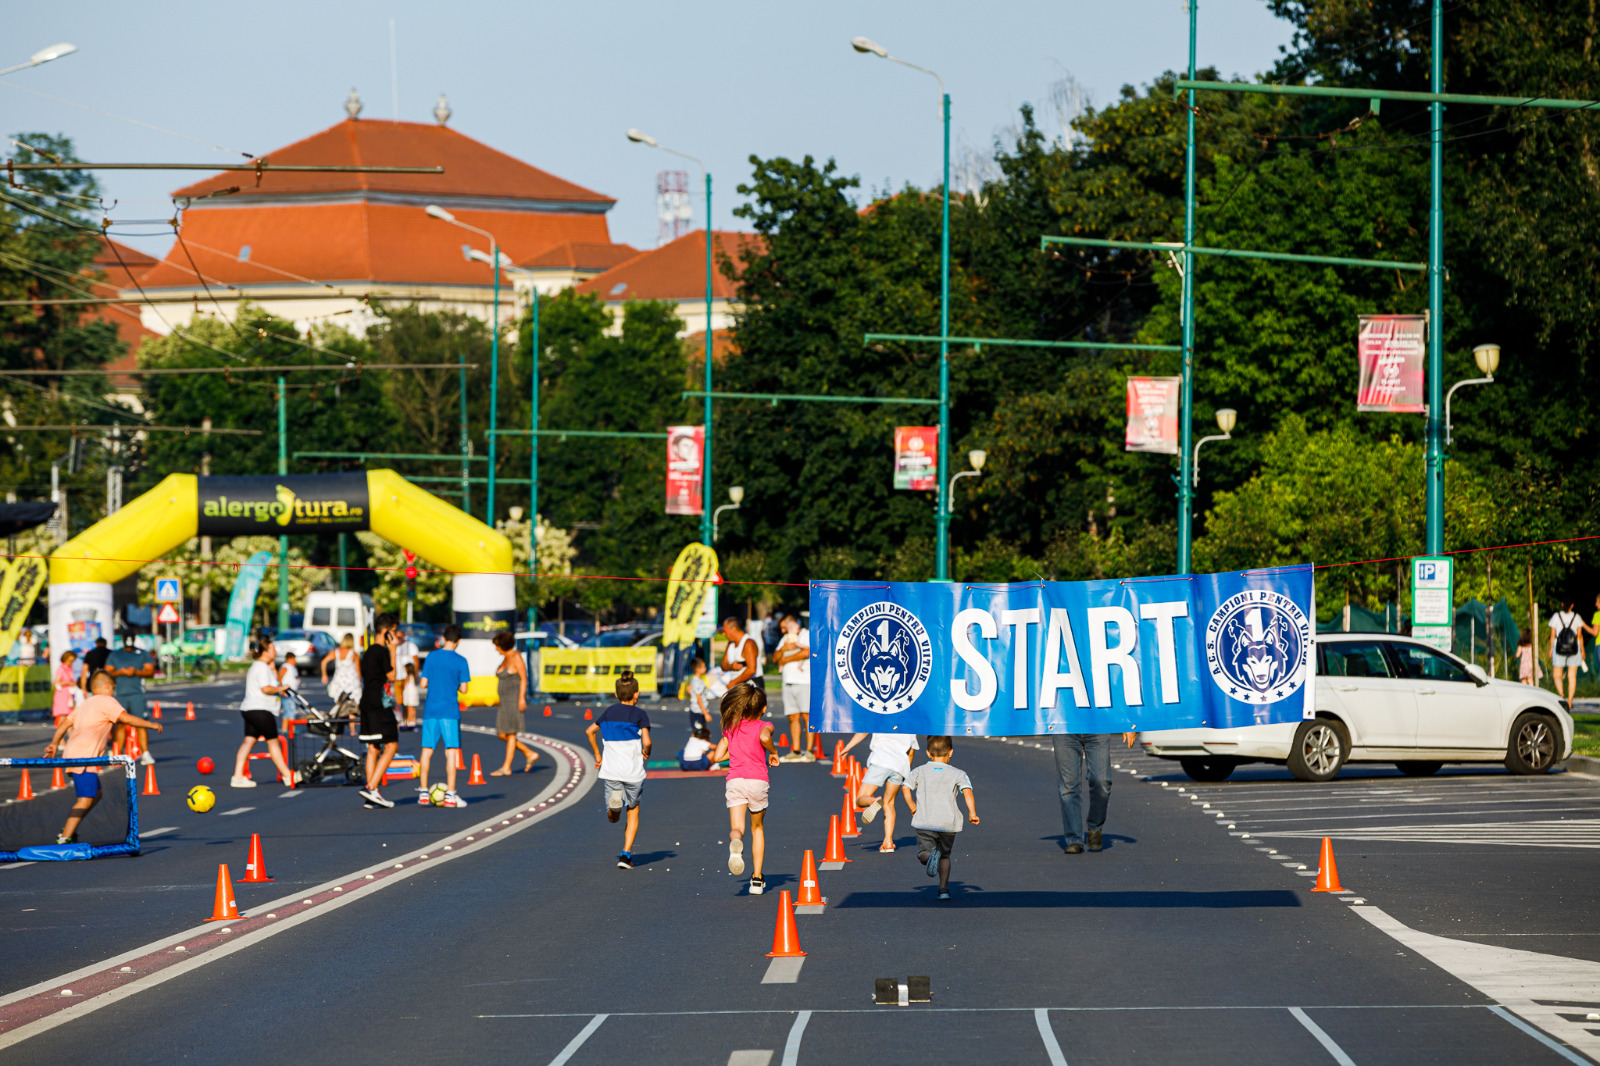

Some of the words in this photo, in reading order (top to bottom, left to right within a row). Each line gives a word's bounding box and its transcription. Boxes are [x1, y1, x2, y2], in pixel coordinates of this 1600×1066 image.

[1424, 564, 1435, 580] P
[1209, 592, 1254, 633] CAMPIONI
[1259, 592, 1303, 621] PENTRU
[1245, 608, 1265, 641] 1
[842, 603, 886, 639] CAMPIONI
[888, 603, 925, 637] PENTRU
[918, 639, 932, 682] VIITOR
[876, 620, 889, 652] 1
[950, 601, 1189, 712] START
